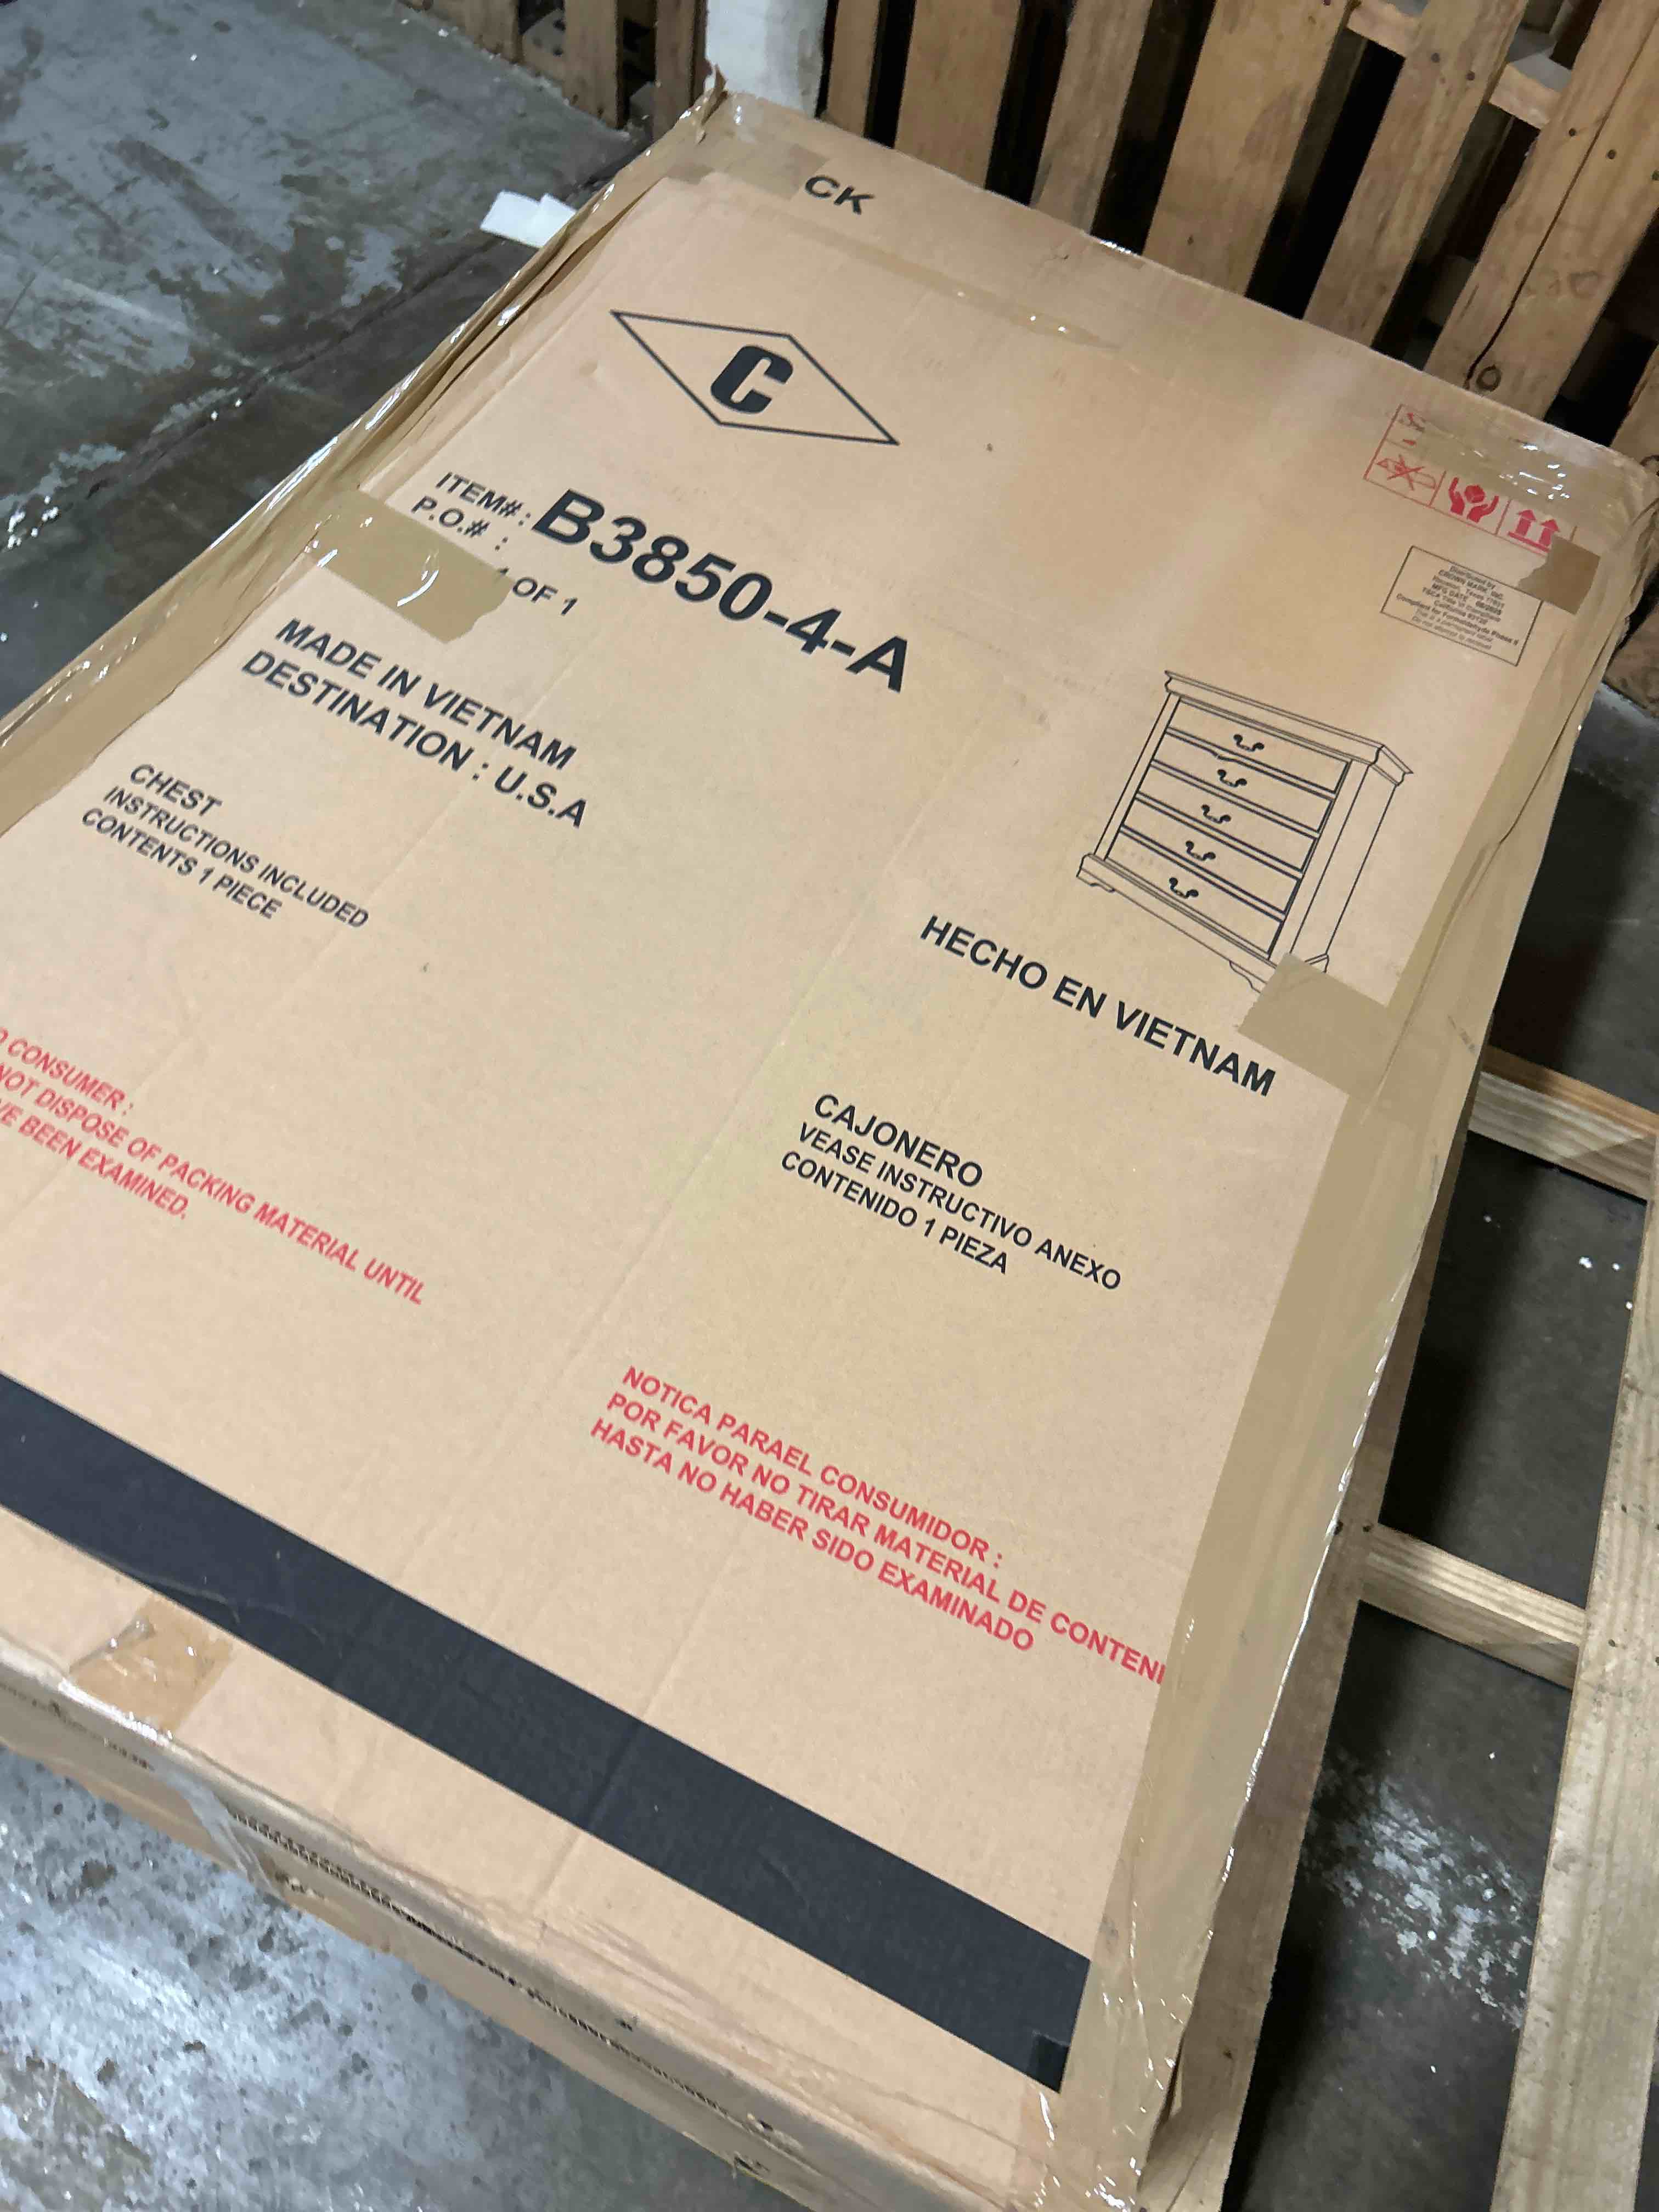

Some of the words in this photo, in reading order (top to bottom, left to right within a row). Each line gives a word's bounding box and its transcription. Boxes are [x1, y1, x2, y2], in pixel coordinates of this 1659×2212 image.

[804, 174, 876, 215] CK
[710, 345, 794, 415] C
[512, 577, 558, 603] OF
[561, 597, 578, 617] 1
[532, 488, 909, 693] B3850-4-A
[241, 650, 473, 777] DESTINATION
[494, 769, 589, 827] U.S.A
[275, 618, 381, 680] MADE
[377, 664, 422, 697] IN
[425, 685, 576, 770] VIETNAM
[103, 786, 259, 873] INSTRUCTIONS
[258, 860, 369, 928] INCLUDED
[130, 763, 222, 817] CHEST
[82, 808, 198, 877] CONTENTS
[201, 867, 213, 887] 1
[212, 874, 282, 921] PIECE
[8, 1037, 125, 1110] CONSUMER
[920, 915, 1047, 990] HECHO
[1052, 975, 1107, 1018] EN
[1116, 1001, 1276, 1097] VIETNAM
[18, 1115, 82, 1160] BEEN
[78, 1147, 189, 1220] EXAMINED.
[35, 1088, 129, 1148] DISPOSE
[127, 1137, 161, 1163] OF
[158, 1153, 256, 1214] PACKING
[254, 1203, 359, 1271] MATERIAL
[364, 1259, 426, 1305] UNTIL
[800, 1123, 875, 1173] VEASE
[877, 1161, 1032, 1248] INSTRUCTIVO
[1035, 1239, 1121, 1290] ANEXO
[814, 1094, 983, 1188] CAJONERO
[782, 1151, 917, 1227] CONTENIDO
[924, 1219, 936, 1237] 1
[939, 1226, 1008, 1274] PIEZA
[591, 1418, 672, 1474] HASTA
[678, 1460, 716, 1493] NO
[719, 1483, 809, 1540] HABER
[811, 1530, 874, 1572] SIDO
[878, 1563, 1034, 1651] EXAMINADO
[607, 1392, 661, 1431] POR
[663, 1420, 749, 1475] FAVOR
[751, 1464, 791, 1496] NO
[798, 1484, 871, 1536] TIRAR
[873, 1525, 998, 1604] MATERIAL
[1008, 1588, 1047, 1623] DE
[622, 1366, 711, 1426] NOTICA
[716, 1413, 812, 1476] PARAEL
[820, 1465, 990, 1564] CONSUMIDOR
